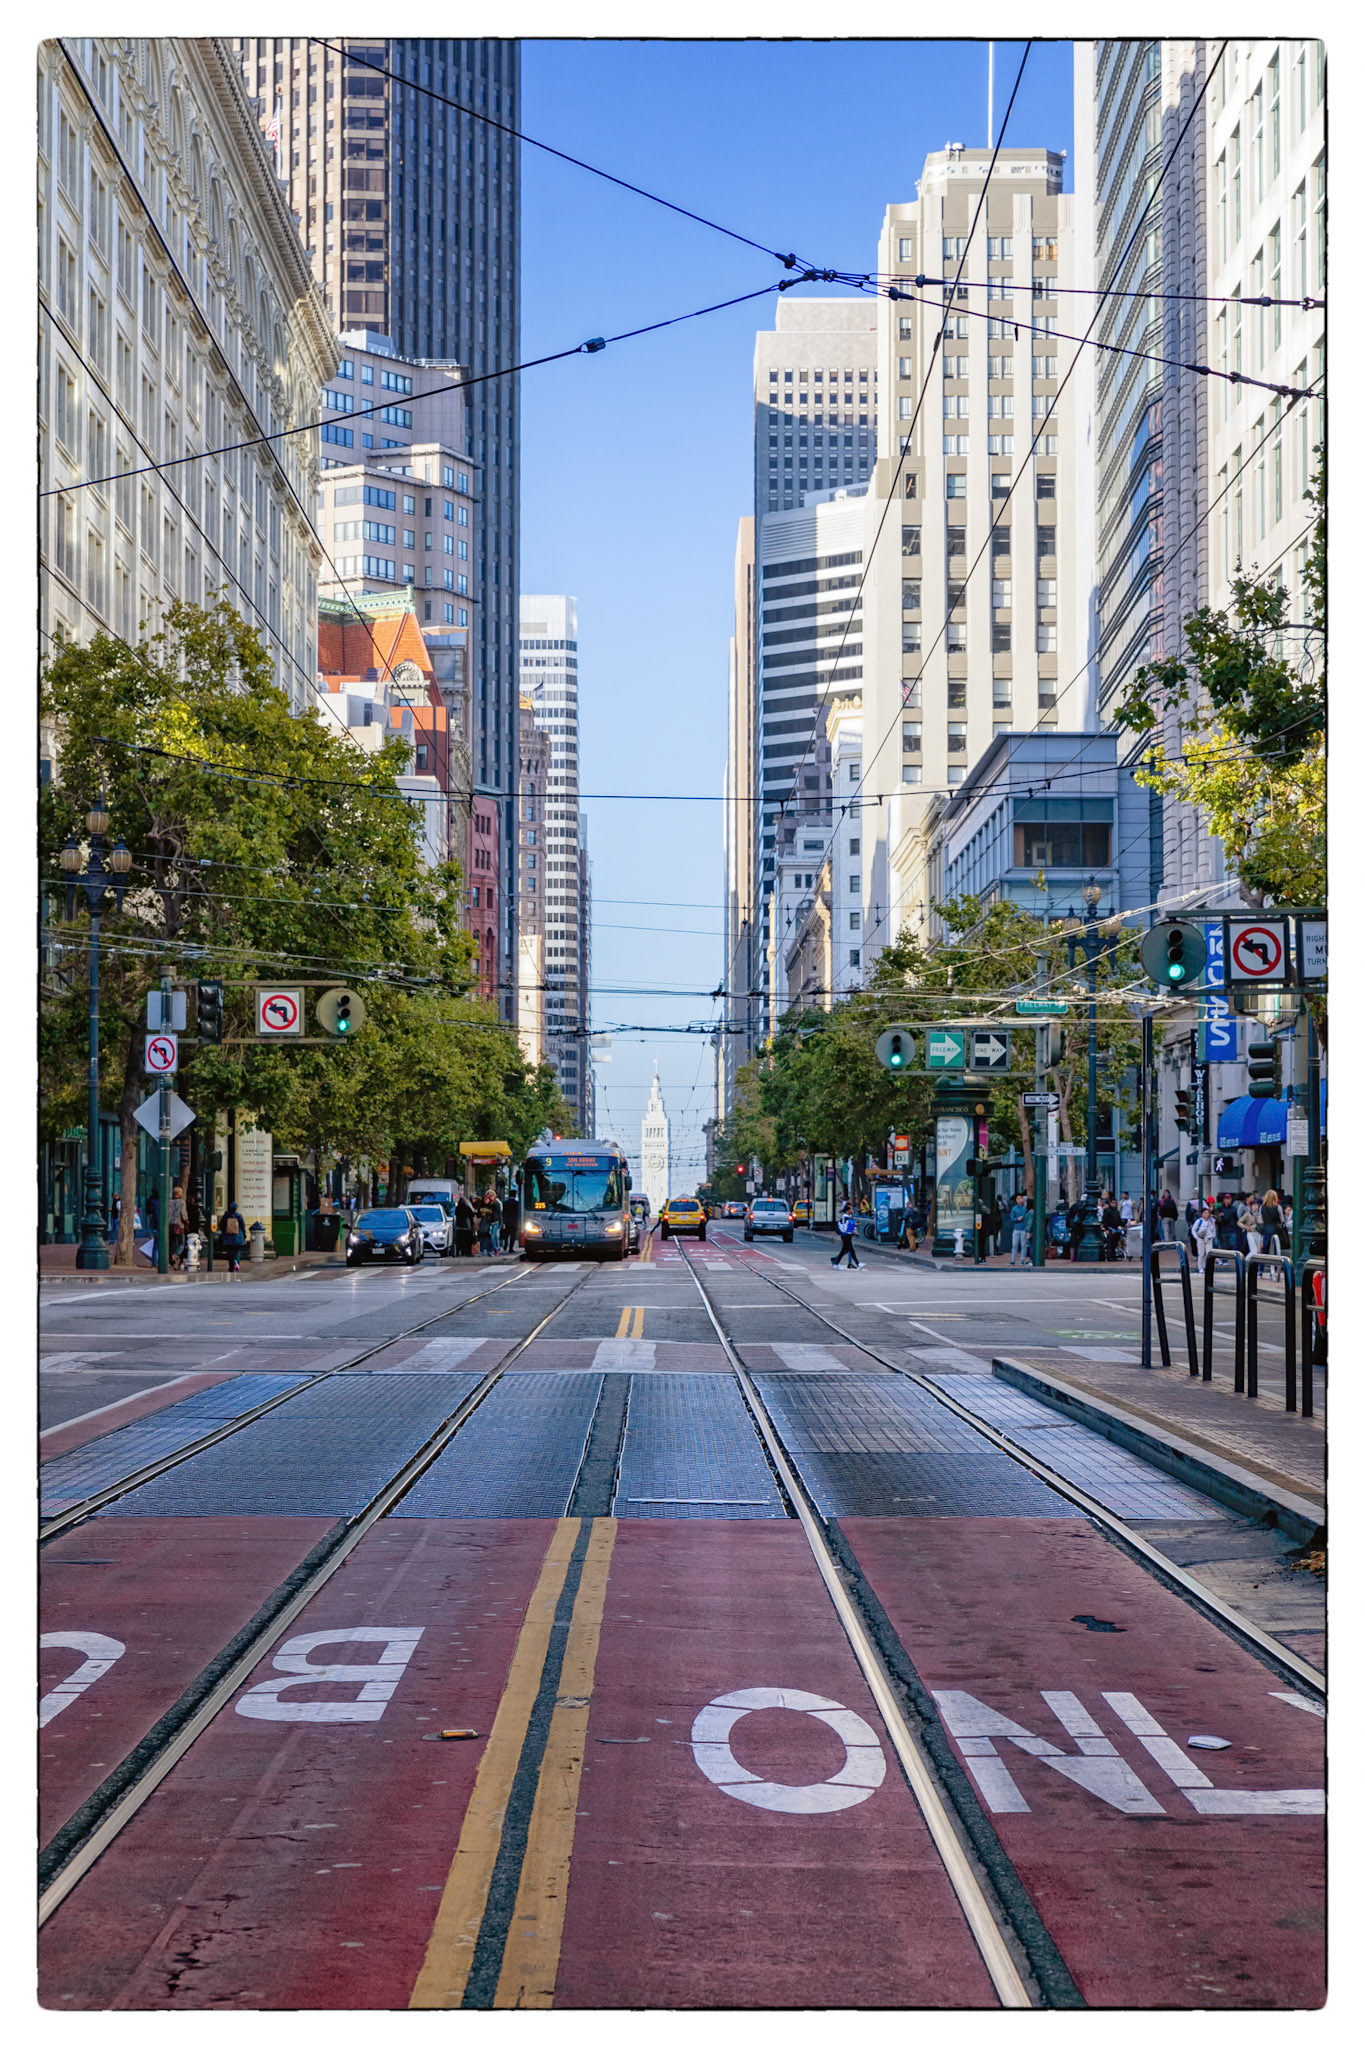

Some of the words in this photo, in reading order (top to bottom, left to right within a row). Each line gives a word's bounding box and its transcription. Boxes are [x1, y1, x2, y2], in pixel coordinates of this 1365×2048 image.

[545, 1157, 552, 1167] 9
[534, 1202, 546, 1210] 215
[690, 1686, 1327, 1817] ONL
